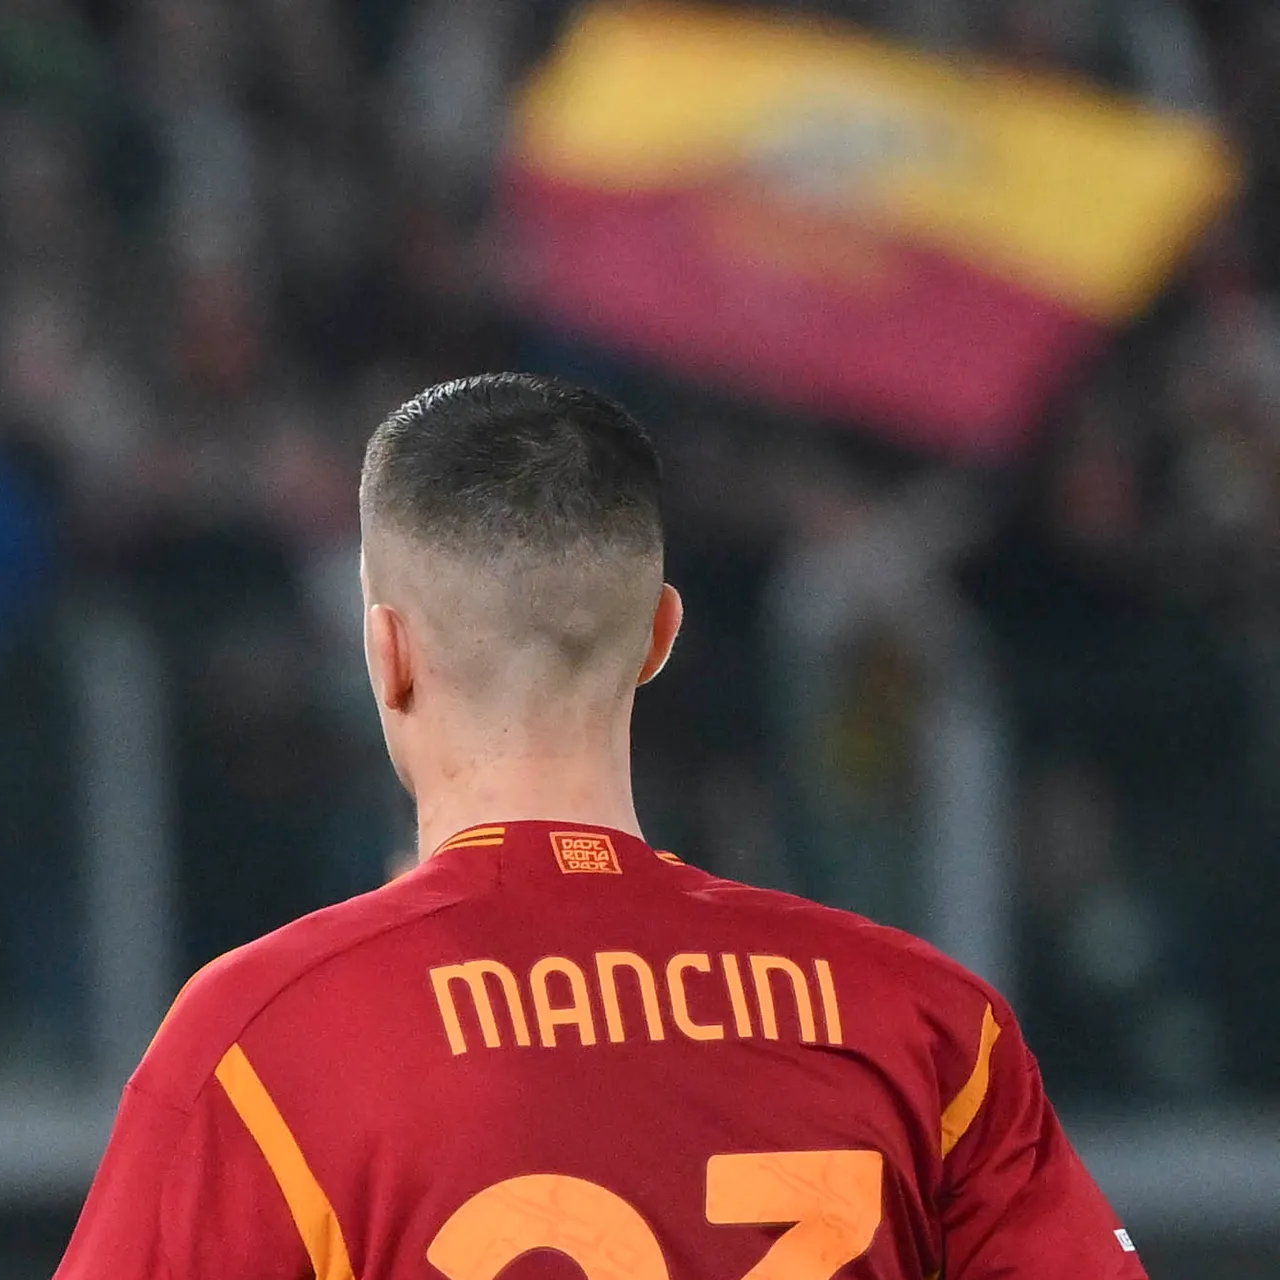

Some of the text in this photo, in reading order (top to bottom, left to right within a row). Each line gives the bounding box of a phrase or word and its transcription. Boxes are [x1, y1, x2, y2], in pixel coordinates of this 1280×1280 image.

[561, 838, 604, 850] DAJE
[562, 849, 609, 862] ROMA
[429, 951, 843, 1056] MANCINI
